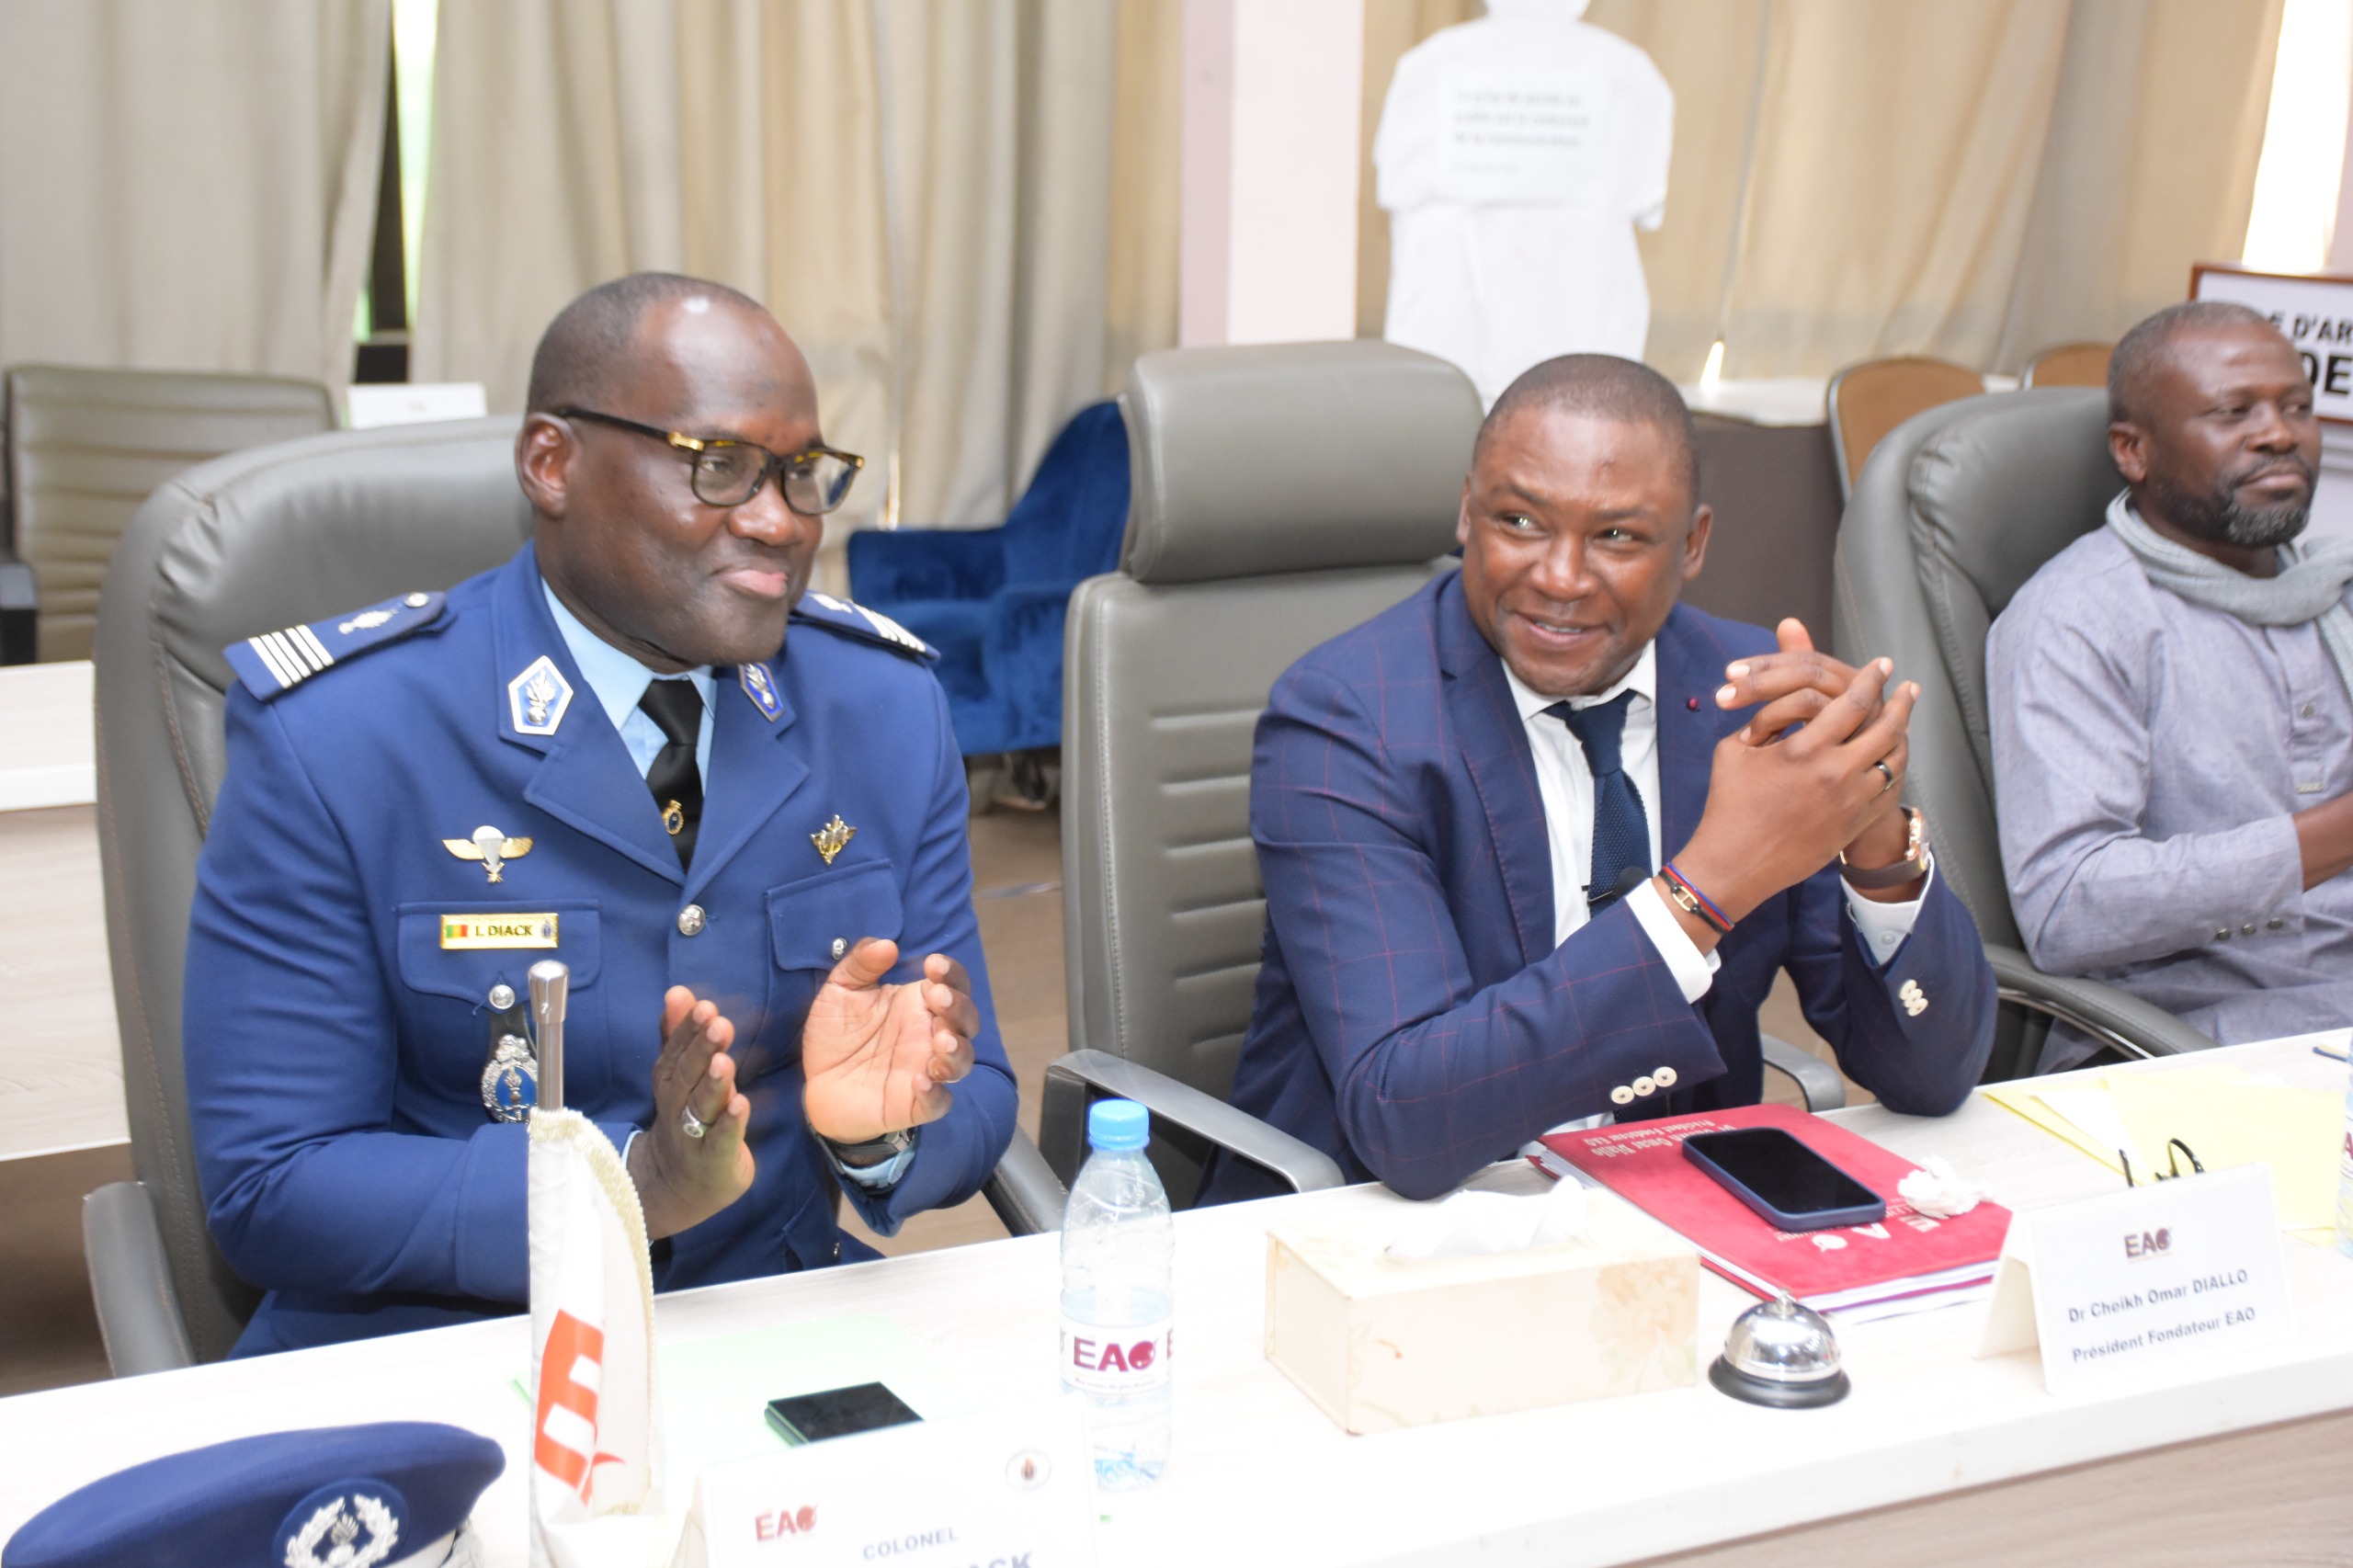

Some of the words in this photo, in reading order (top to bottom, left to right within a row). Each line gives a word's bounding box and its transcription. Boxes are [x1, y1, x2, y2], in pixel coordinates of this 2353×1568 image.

[488, 925, 532, 937] DIACK
[1593, 1144, 1635, 1157] Diallo
[1610, 1129, 1664, 1142] Fondateur
[1632, 1138, 1672, 1148] Omar
[2068, 1308, 2085, 1323] Dr
[2090, 1294, 2143, 1318] Cheikh
[2147, 1286, 2188, 1304] Omar
[2192, 1268, 2248, 1294] DIALLO
[2147, 1317, 2221, 1345] Fondateur
[2224, 1306, 2256, 1326] EAO
[1074, 1335, 1156, 1372] EAO
[755, 1504, 818, 1542] EAO
[862, 1526, 961, 1561] COLONEL
